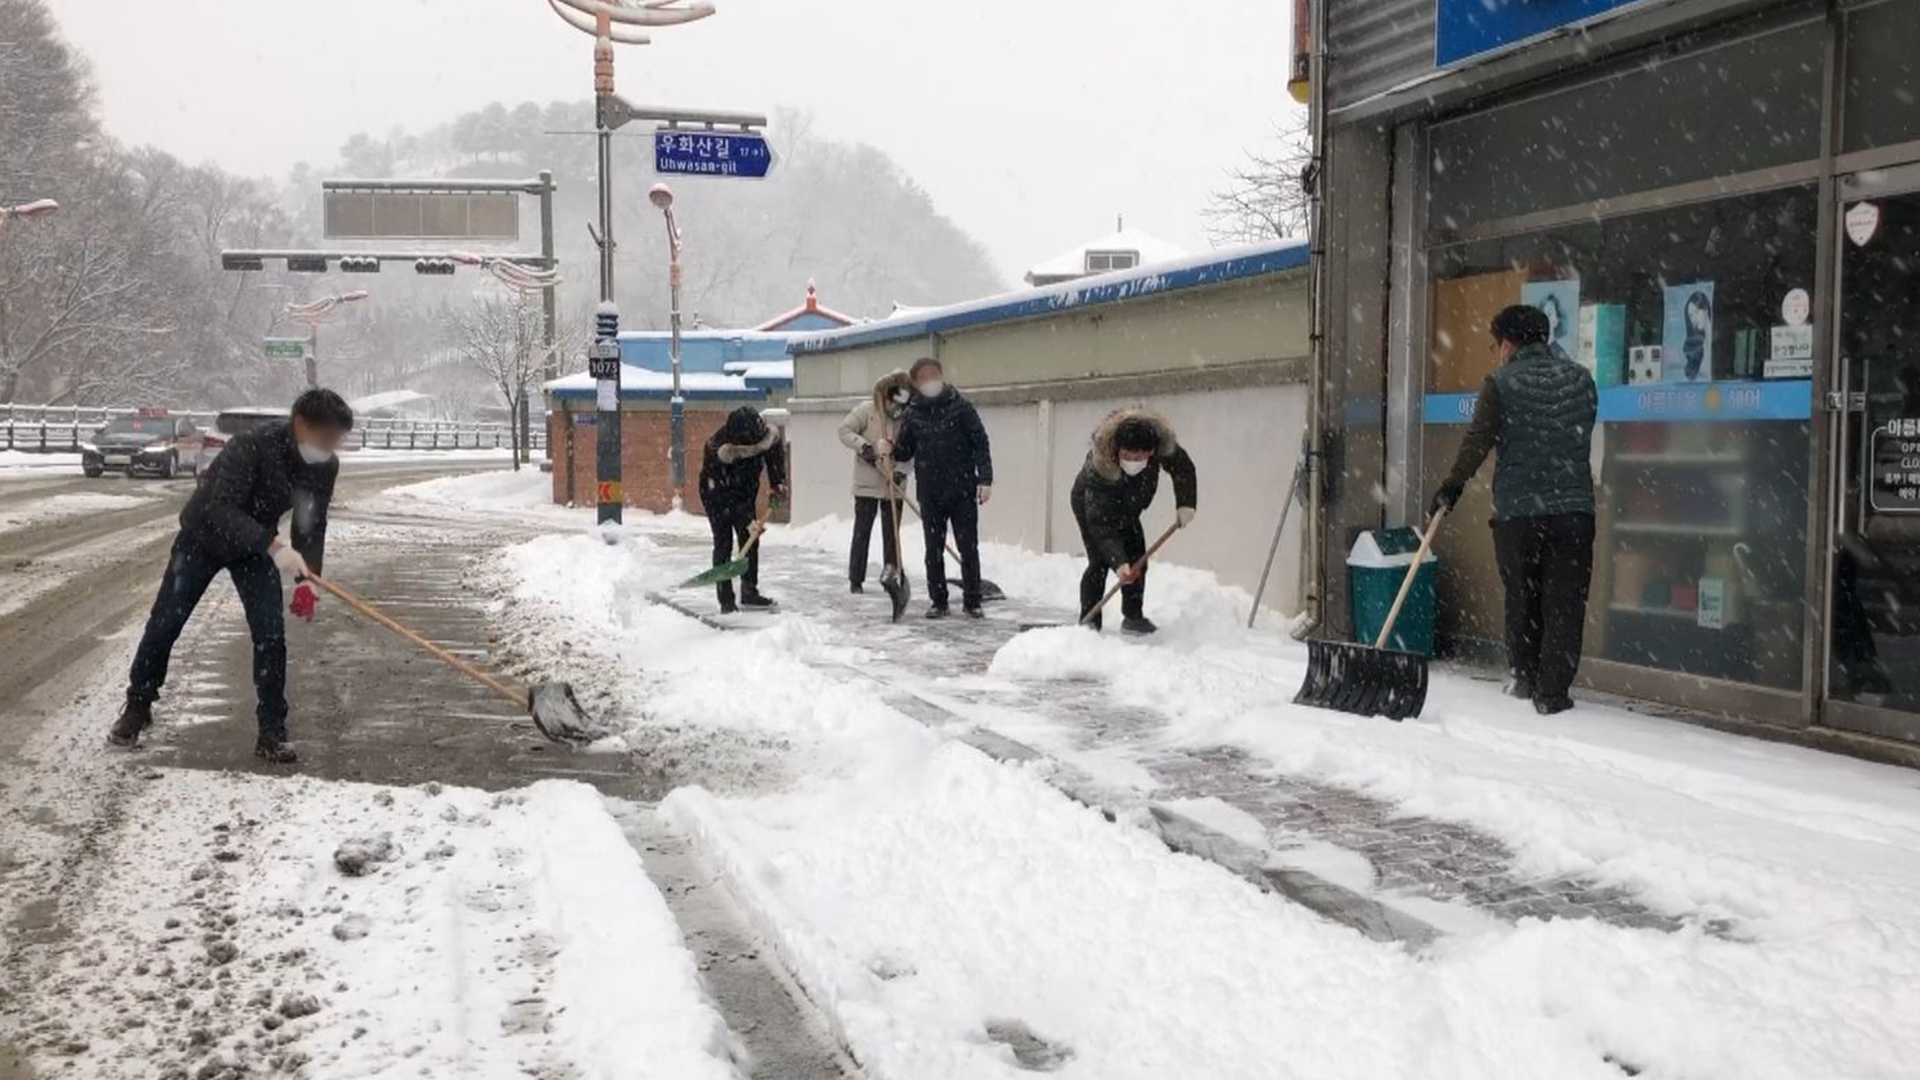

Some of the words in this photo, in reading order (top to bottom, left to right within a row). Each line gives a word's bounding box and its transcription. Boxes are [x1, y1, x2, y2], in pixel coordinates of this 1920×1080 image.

[660, 135, 730, 159] 우화산길
[660, 157, 737, 174] Uhwasan-gil
[592, 361, 617, 374] 1073
